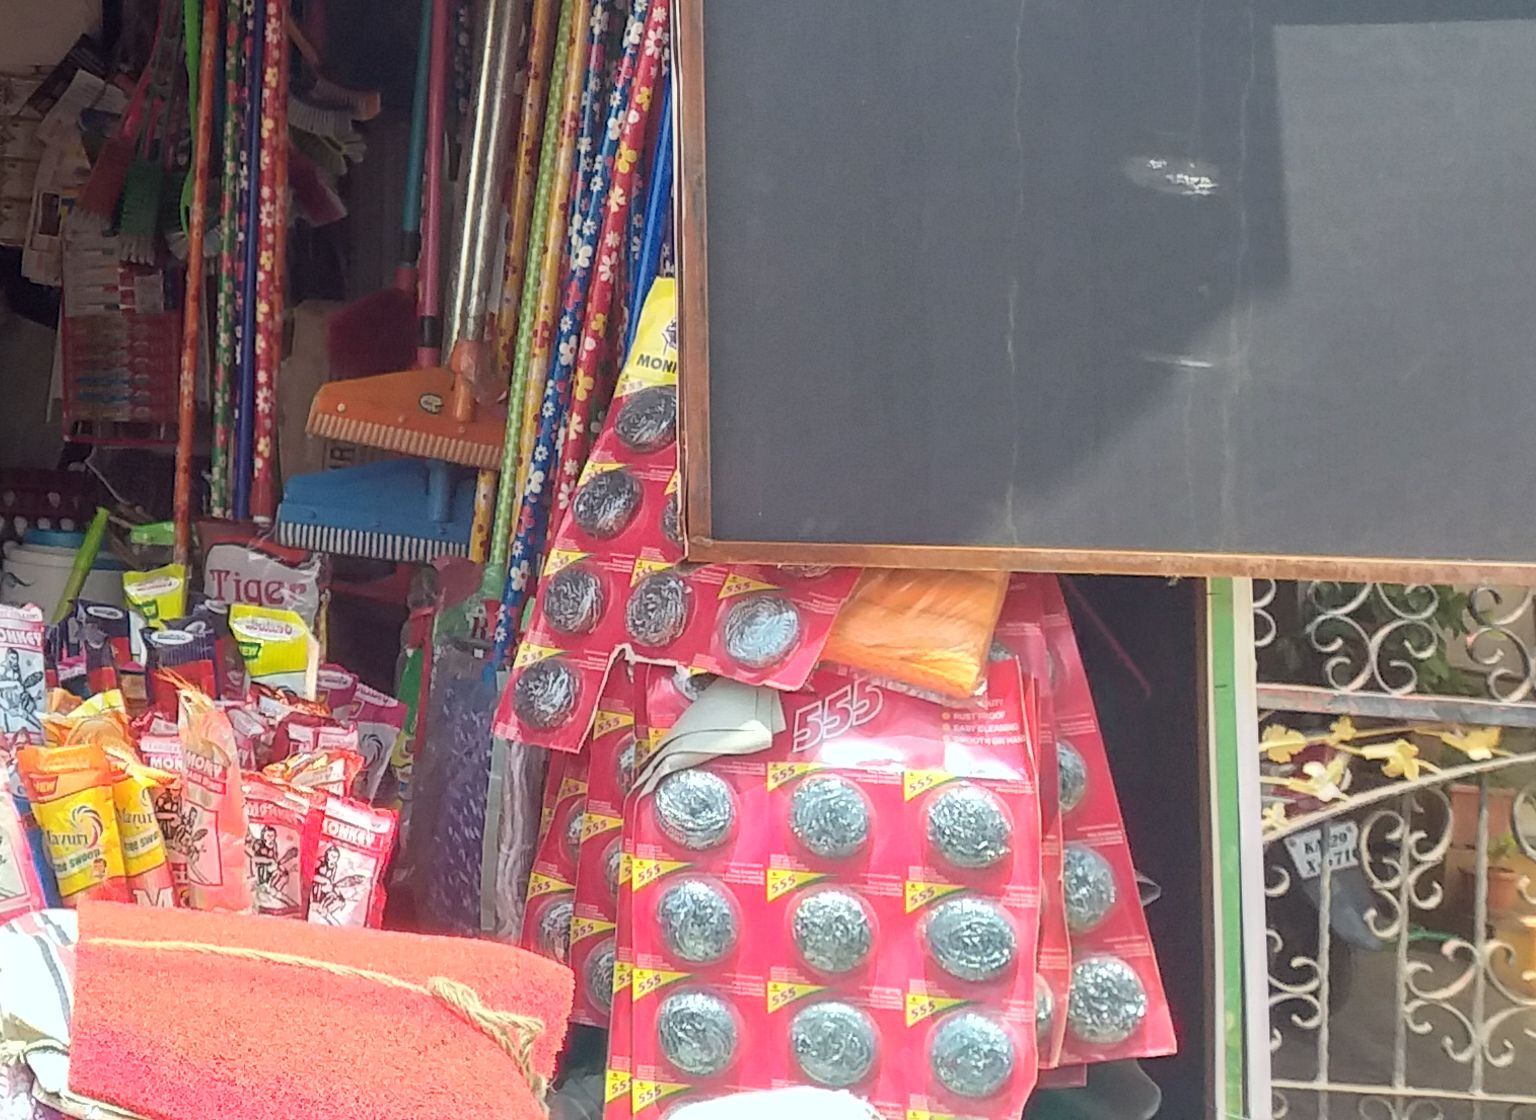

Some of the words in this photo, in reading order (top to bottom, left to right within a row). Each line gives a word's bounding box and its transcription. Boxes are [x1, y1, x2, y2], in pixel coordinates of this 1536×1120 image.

[725, 581, 752, 594] 555
[521, 650, 544, 663] 555
[597, 715, 621, 732] 555
[793, 677, 884, 755] 555
[953, 723, 977, 733] EASY
[977, 722, 1020, 733] CLEANING
[772, 766, 796, 783] 555
[908, 775, 934, 793] 555
[585, 819, 608, 837] 555
[638, 864, 661, 883] 555
[530, 881, 551, 895] 555
[771, 875, 797, 894] 555
[910, 888, 936, 906] 555
[637, 972, 663, 994] 555
[771, 987, 797, 1006] 555
[911, 999, 937, 1020] 555
[637, 1083, 663, 1105] 555
